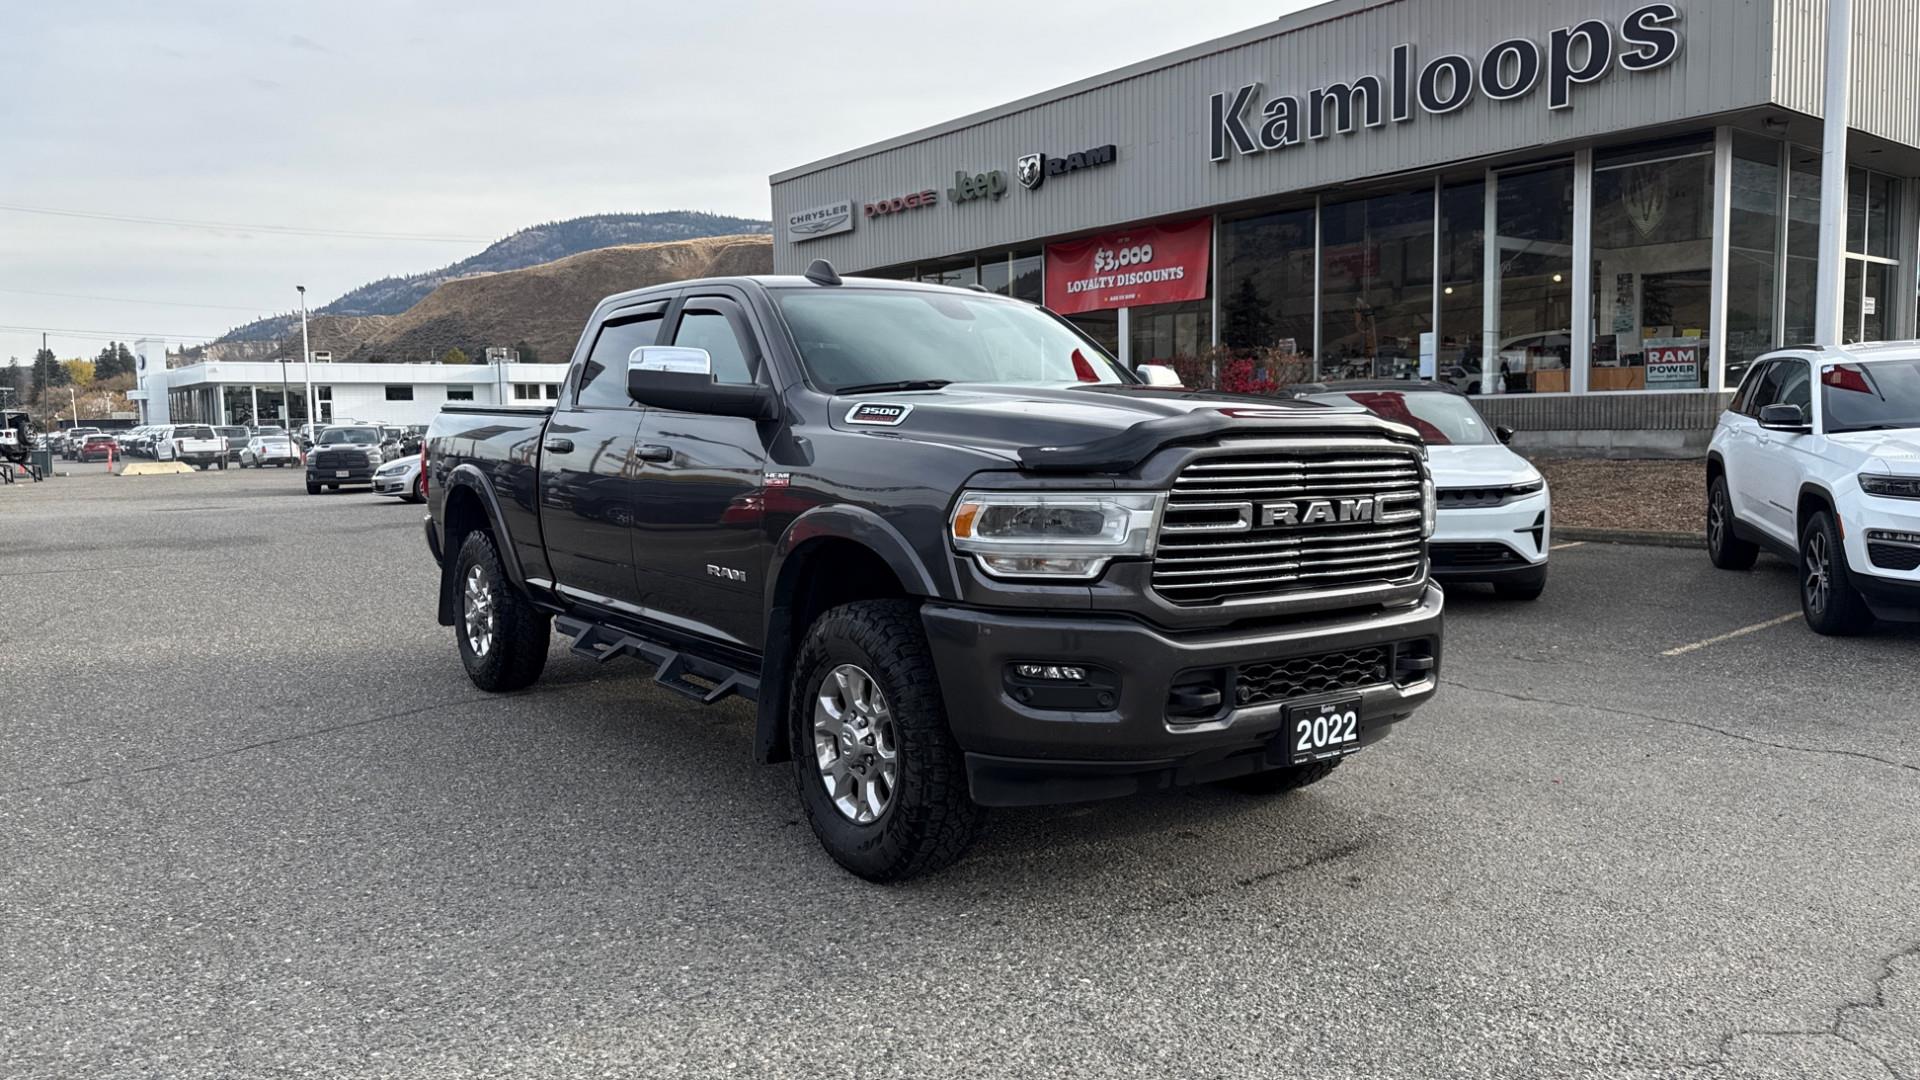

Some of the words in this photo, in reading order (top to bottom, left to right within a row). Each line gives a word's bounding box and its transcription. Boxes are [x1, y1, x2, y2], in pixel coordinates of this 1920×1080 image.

[1209, 3, 1682, 162] Kamloops
[1045, 145, 1117, 176] RAM
[947, 170, 1007, 204] Jeep
[790, 205, 848, 225] CHRYSLER
[864, 189, 937, 218] DODGE
[1094, 244, 1153, 273] $3,000
[1067, 276, 1115, 293] LOYALTY
[1117, 266, 1184, 286] DISCOUNTS
[1648, 350, 1695, 362] RAM
[1649, 364, 1695, 373] POWER
[860, 407, 900, 416] 3500
[1261, 499, 1373, 525] RAM
[706, 564, 747, 582] RAM
[1297, 711, 1357, 751] 2022
